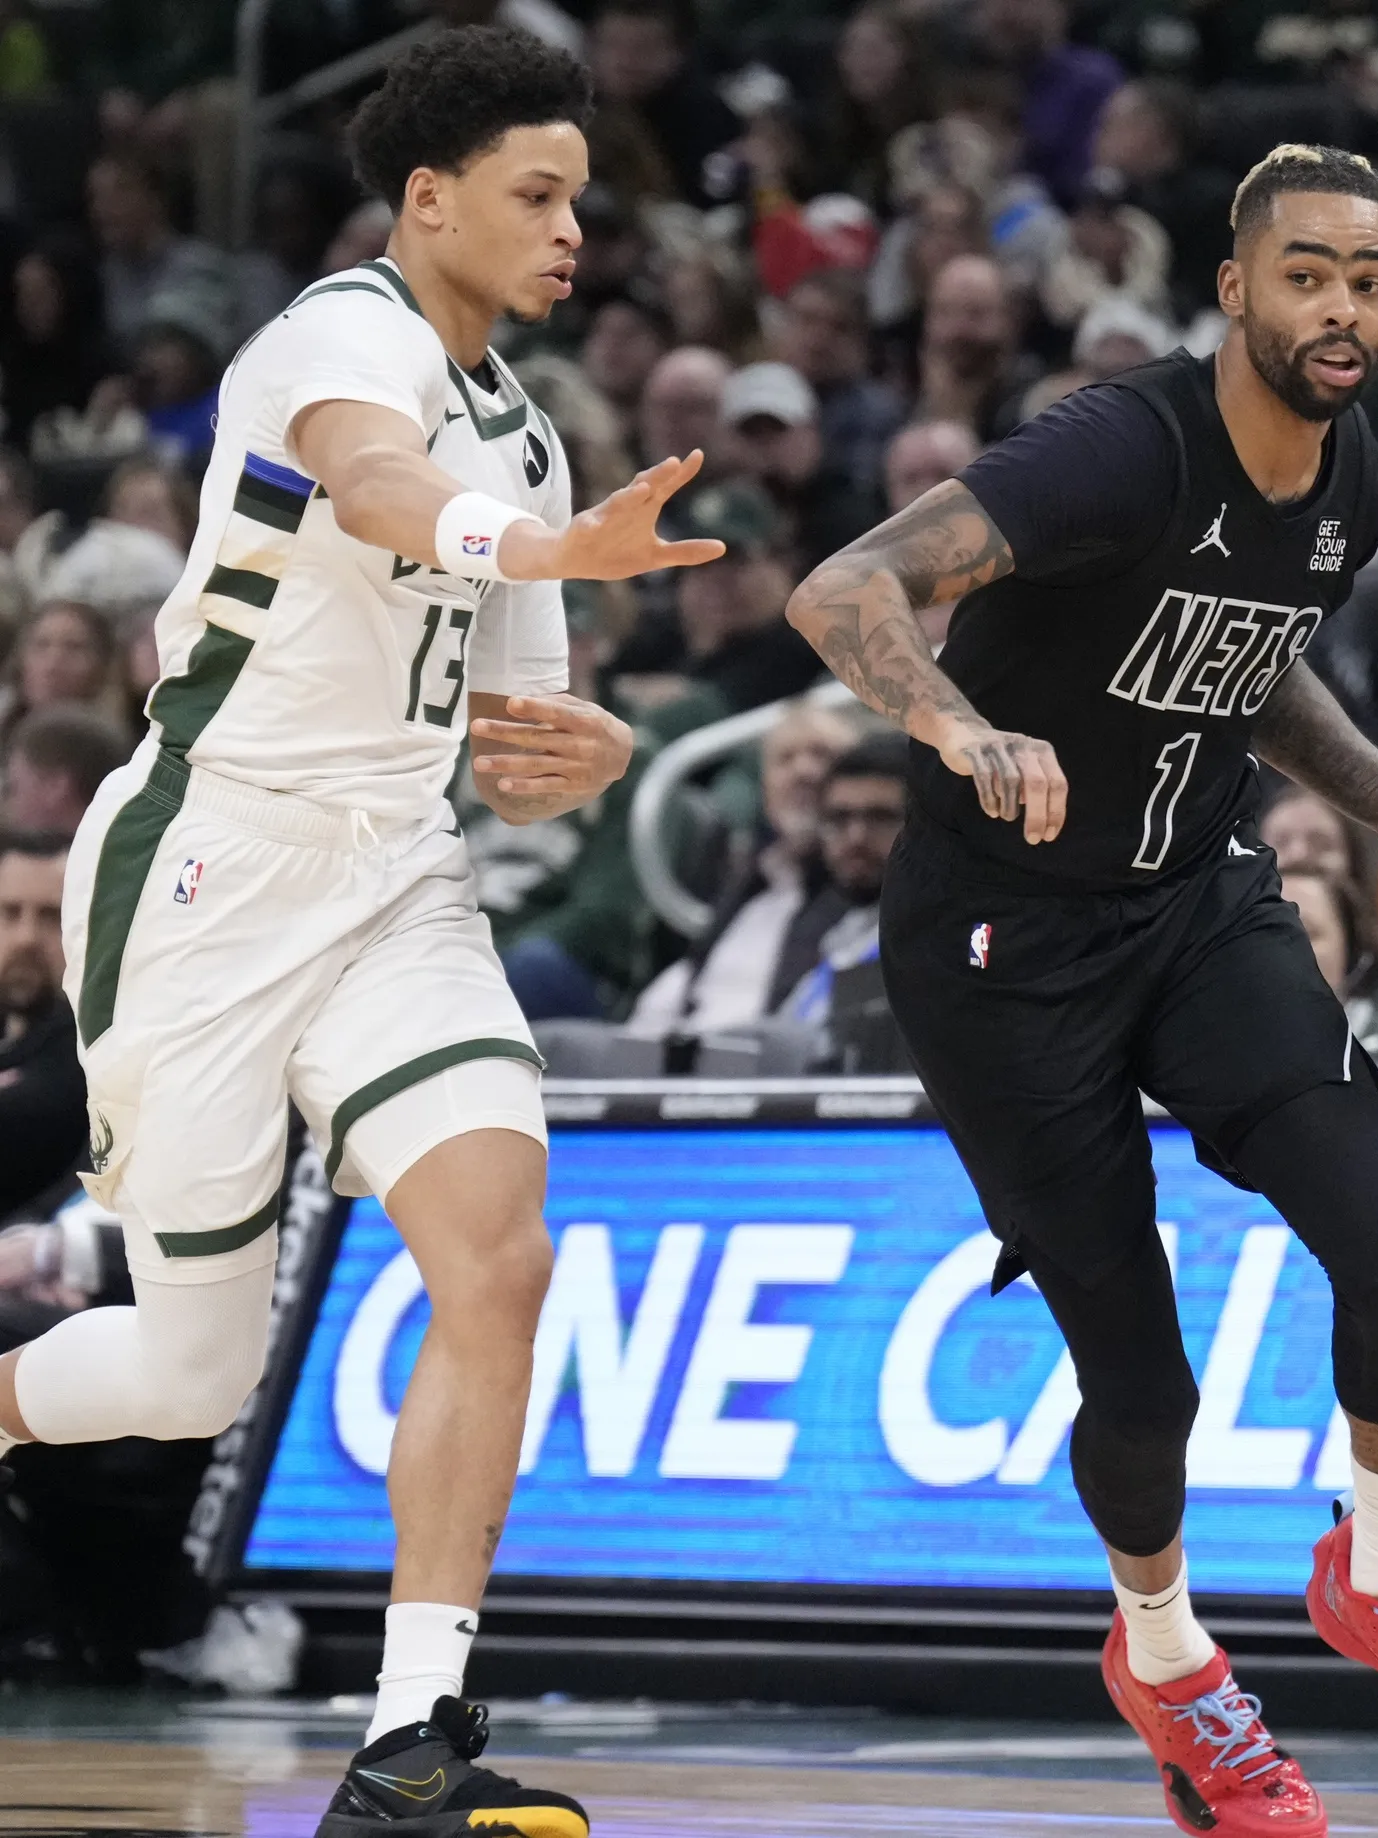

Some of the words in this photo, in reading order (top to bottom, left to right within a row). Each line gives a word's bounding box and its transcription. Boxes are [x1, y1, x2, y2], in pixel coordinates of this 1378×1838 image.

[1309, 554, 1344, 572] GUIDE
[1315, 537, 1347, 555] YOUR
[1318, 520, 1341, 537] GET
[403, 603, 475, 730] 13
[1106, 588, 1323, 717] NETS
[1131, 732, 1202, 870] 1
